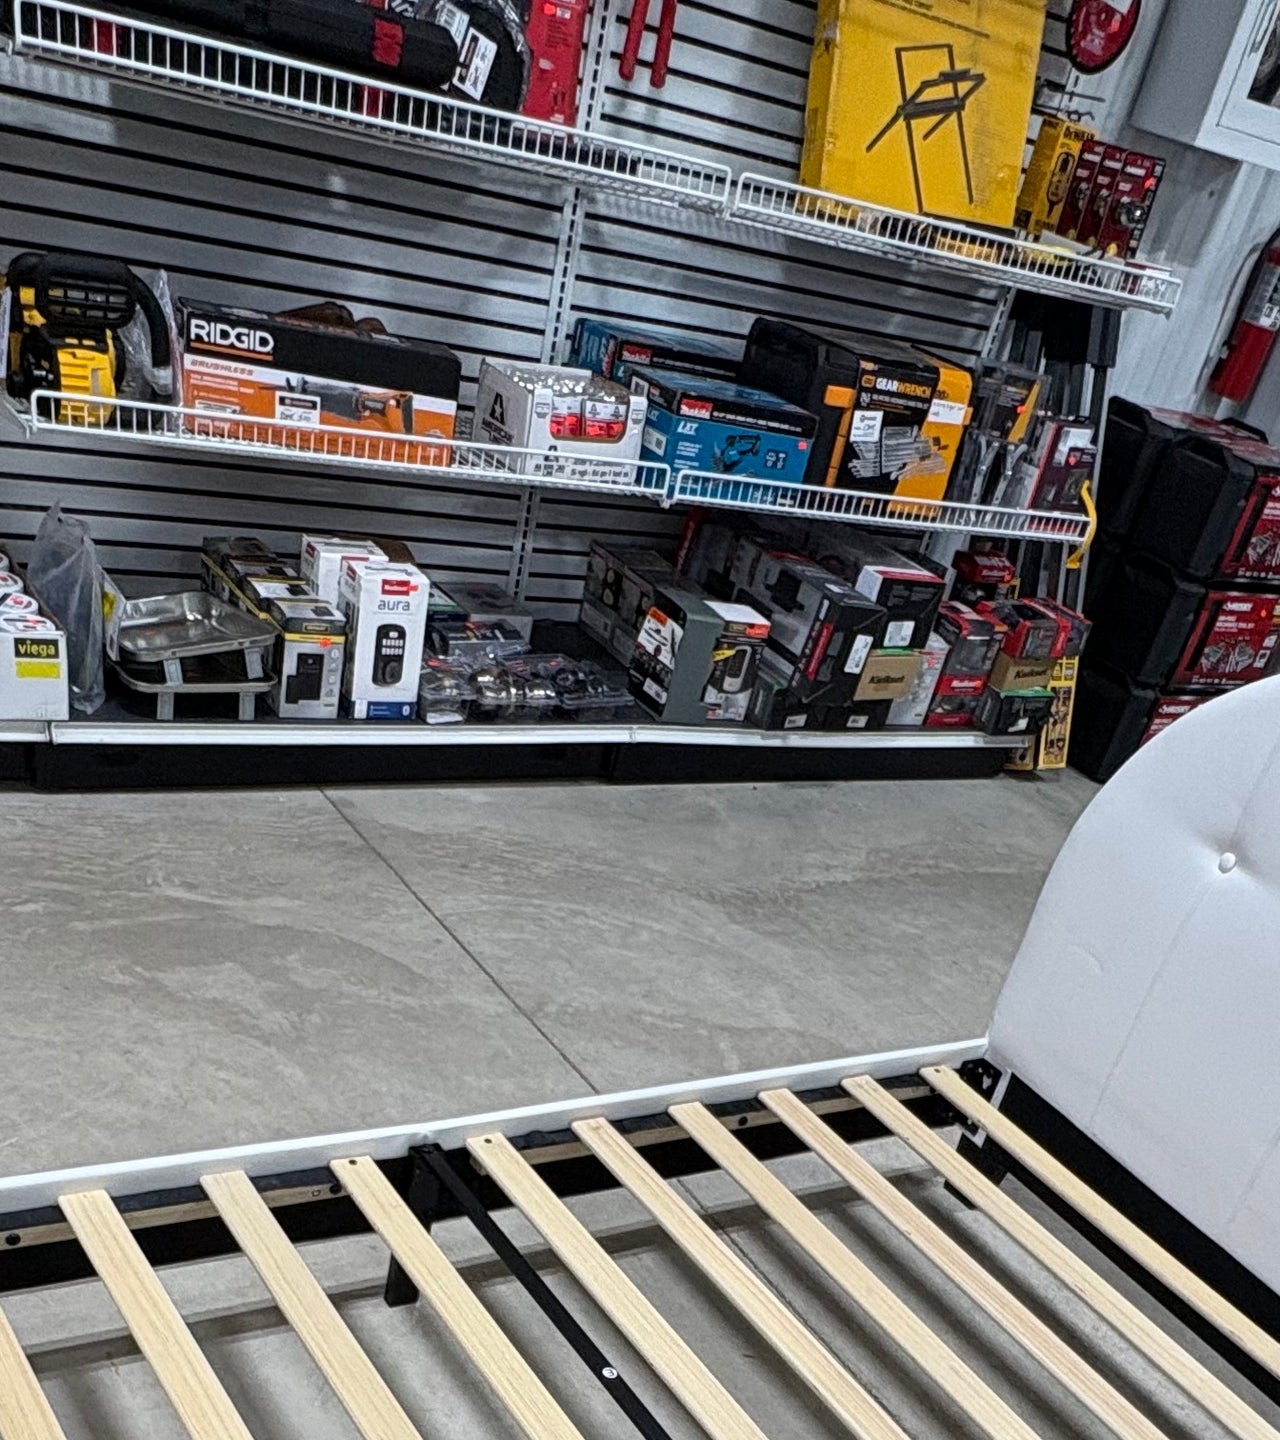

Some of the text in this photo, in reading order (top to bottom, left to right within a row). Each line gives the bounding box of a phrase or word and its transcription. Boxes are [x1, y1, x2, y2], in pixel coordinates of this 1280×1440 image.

[189, 319, 275, 353] RIDGID
[377, 597, 411, 612] aura
[17, 638, 57, 658] viega
